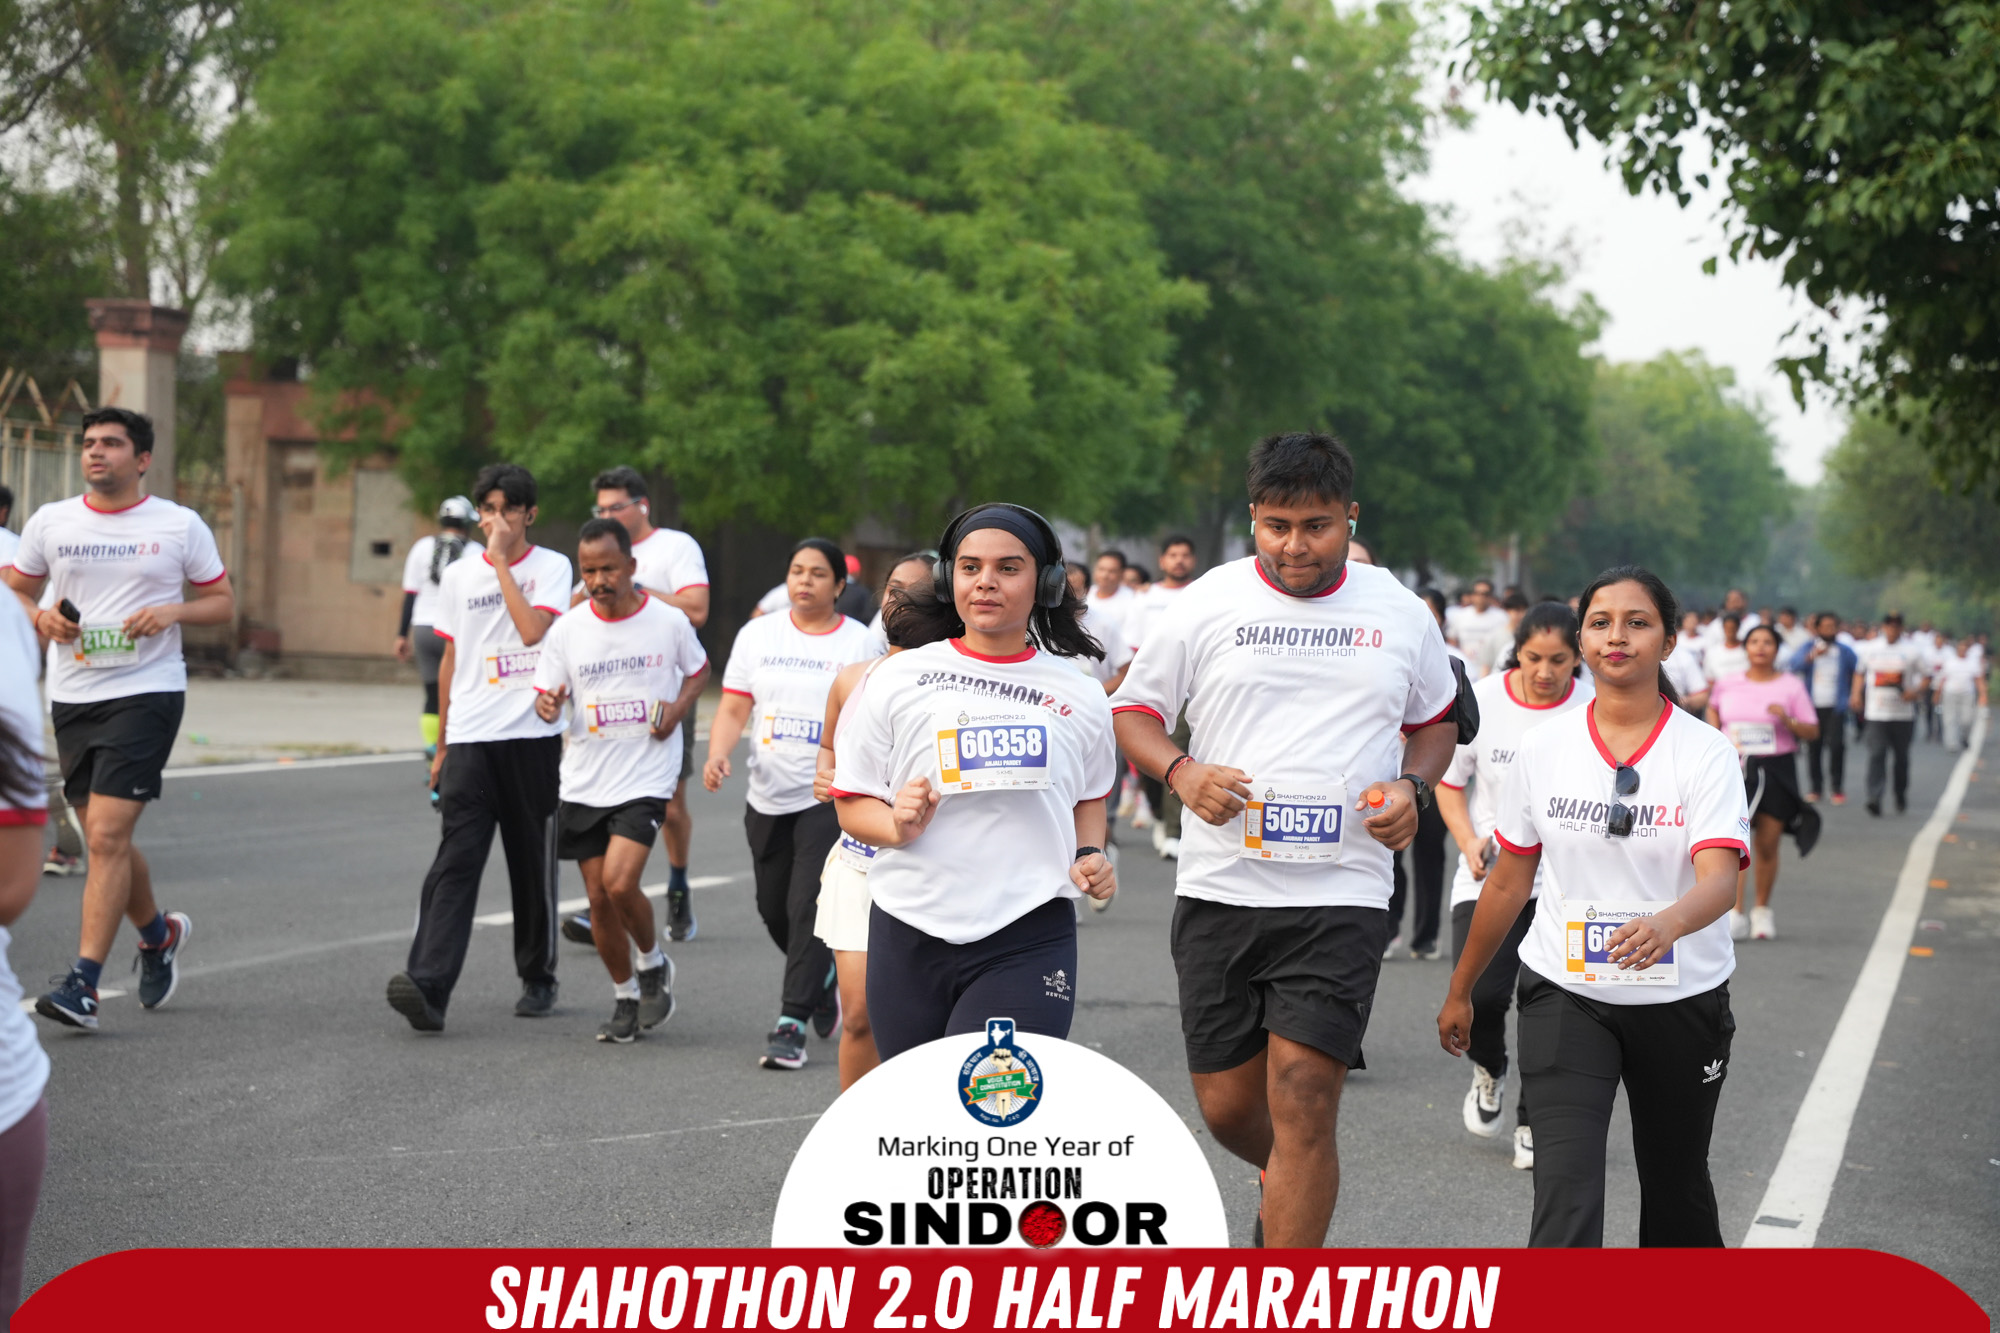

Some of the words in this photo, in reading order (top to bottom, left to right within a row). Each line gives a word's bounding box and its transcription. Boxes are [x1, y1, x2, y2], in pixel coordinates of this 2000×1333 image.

[1235, 626, 1383, 649] SHAHOTHON2.0
[1253, 646, 1284, 656] HALF
[1288, 647, 1356, 657] MARATHON
[597, 702, 645, 724] 10593
[773, 717, 819, 740] 60031
[960, 728, 1043, 760] 60358
[1265, 805, 1338, 834] 50570
[1559, 821, 1586, 832] HALF
